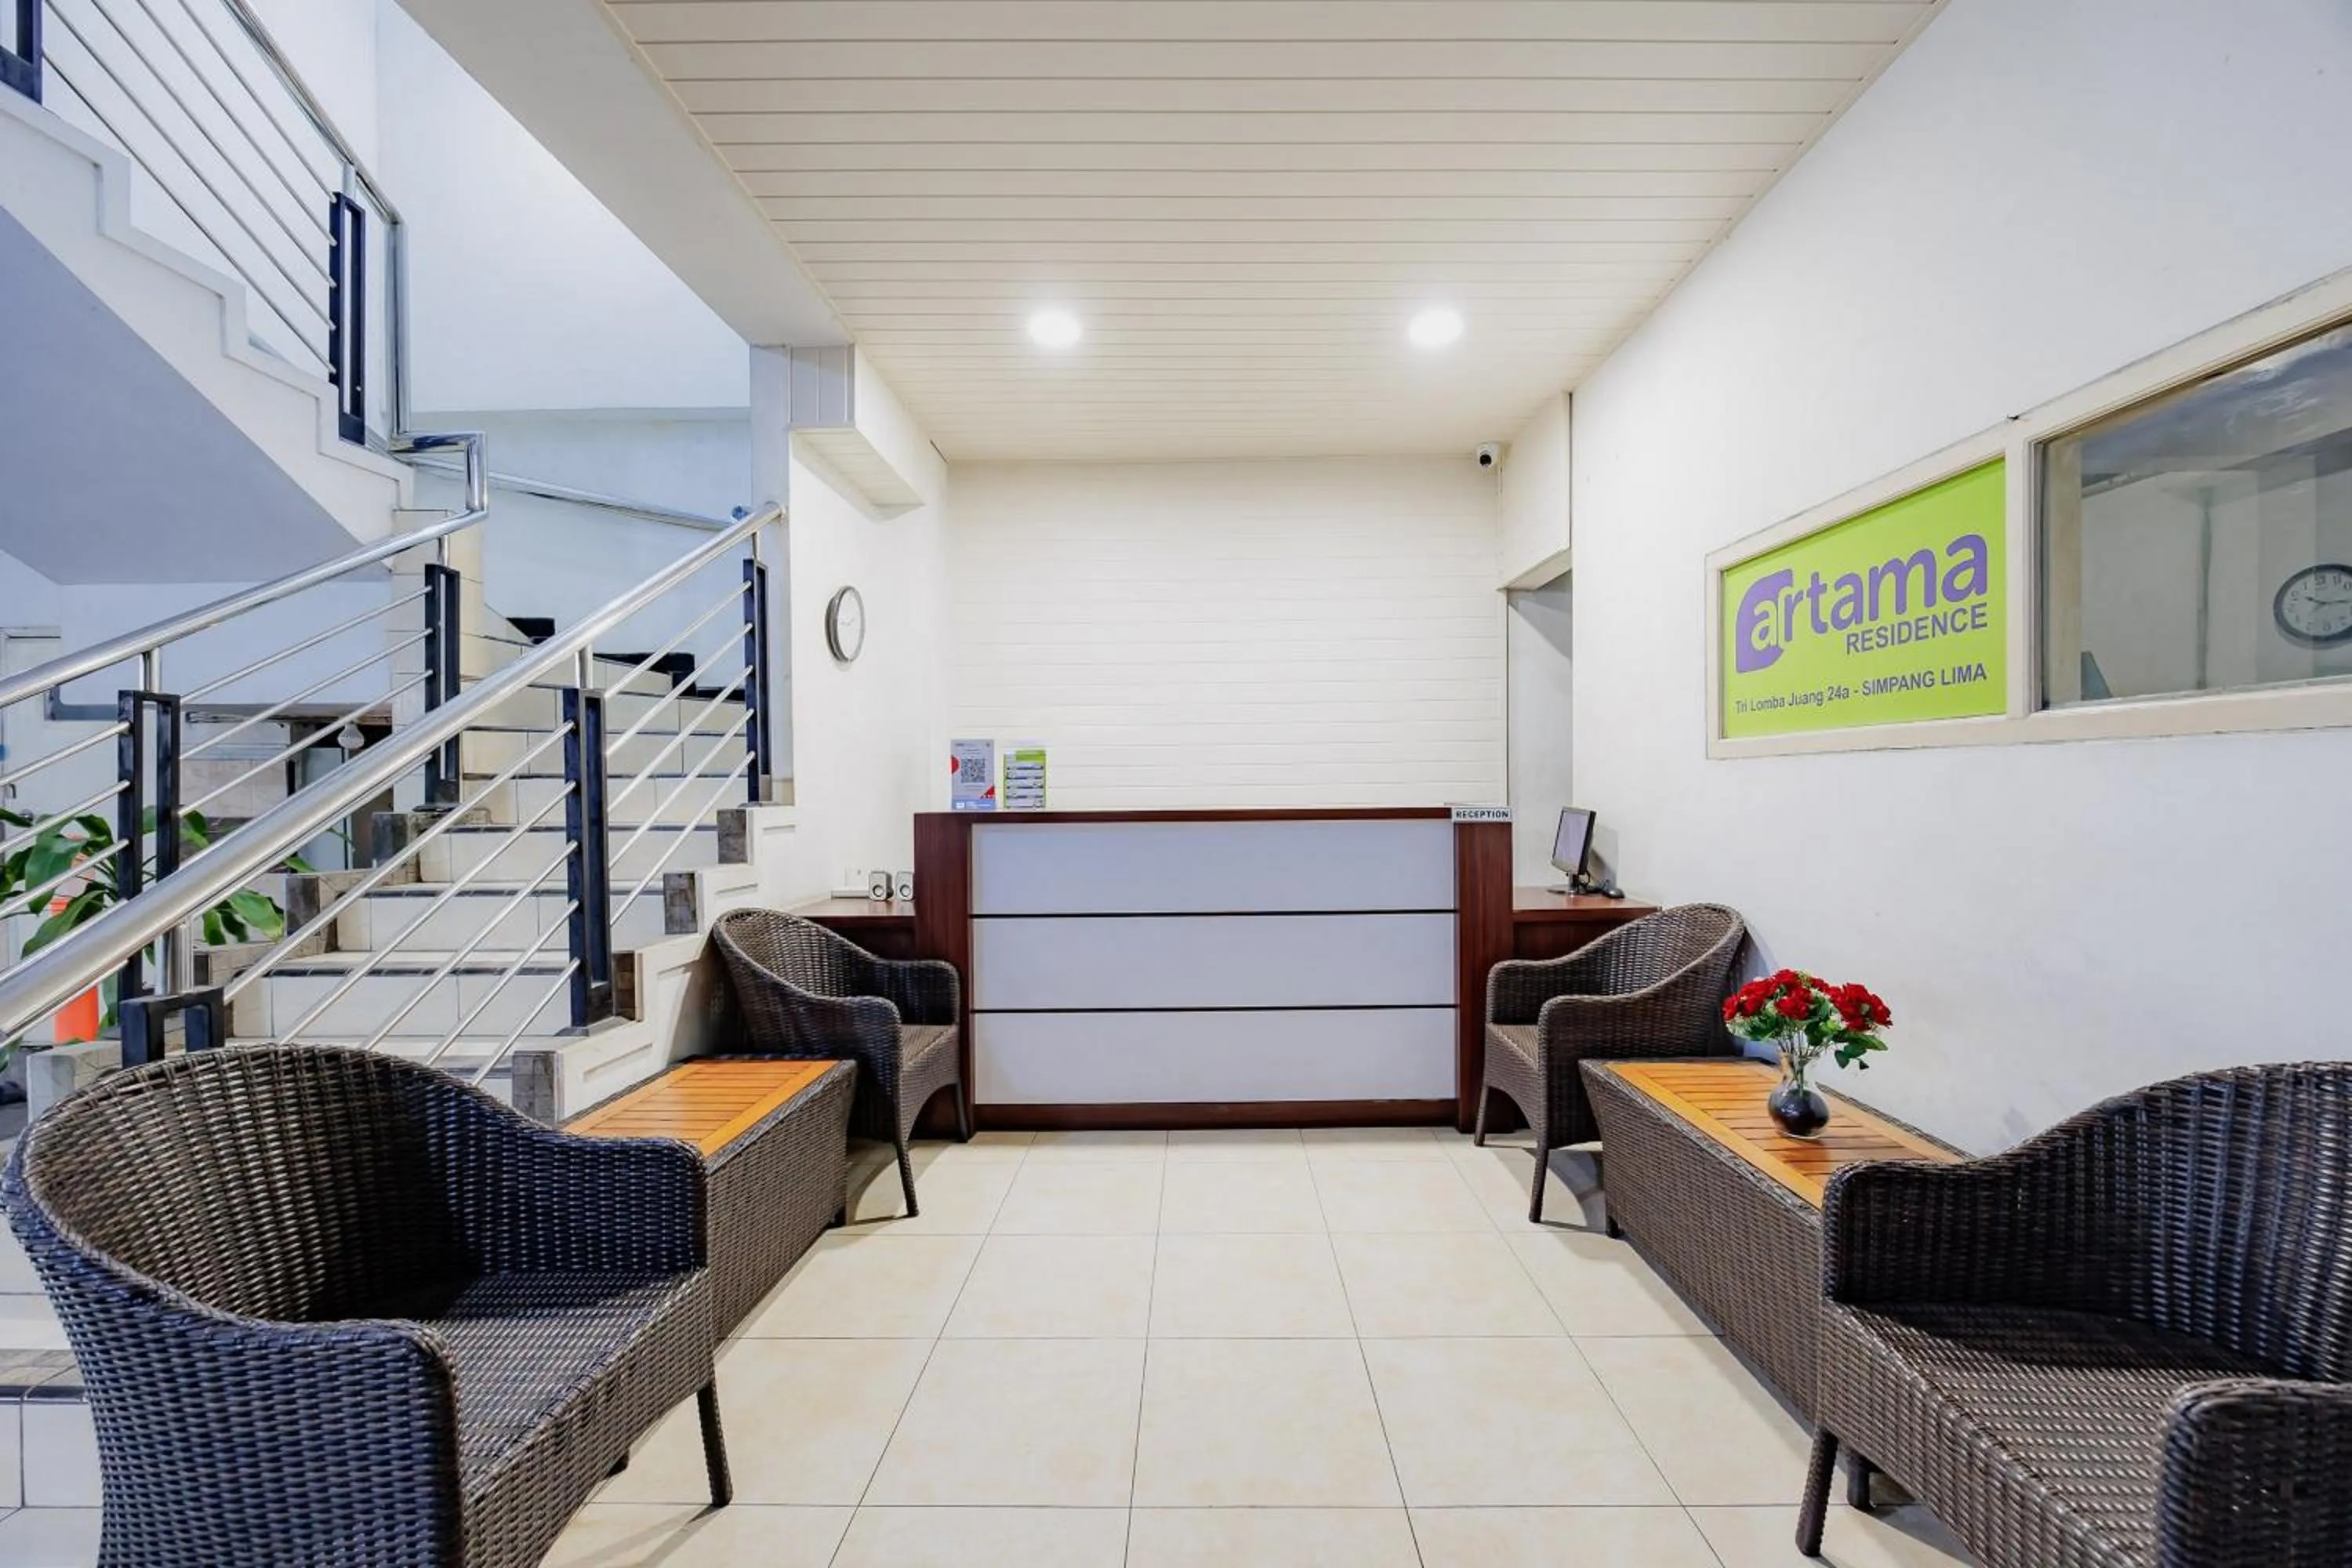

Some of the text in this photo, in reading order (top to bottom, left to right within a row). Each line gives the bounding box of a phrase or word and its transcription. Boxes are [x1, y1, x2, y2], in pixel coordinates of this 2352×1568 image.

[1846, 602, 1987, 655] RESIDENCE
[1736, 700, 1748, 713] Tri
[1751, 696, 1785, 711] Lomba
[1788, 691, 1824, 706] Juang
[1828, 686, 1849, 701] 24a
[1862, 670, 1935, 696] SIMPANG
[1941, 663, 1987, 686] LIMA
[1456, 810, 1509, 819] RECEPTION
